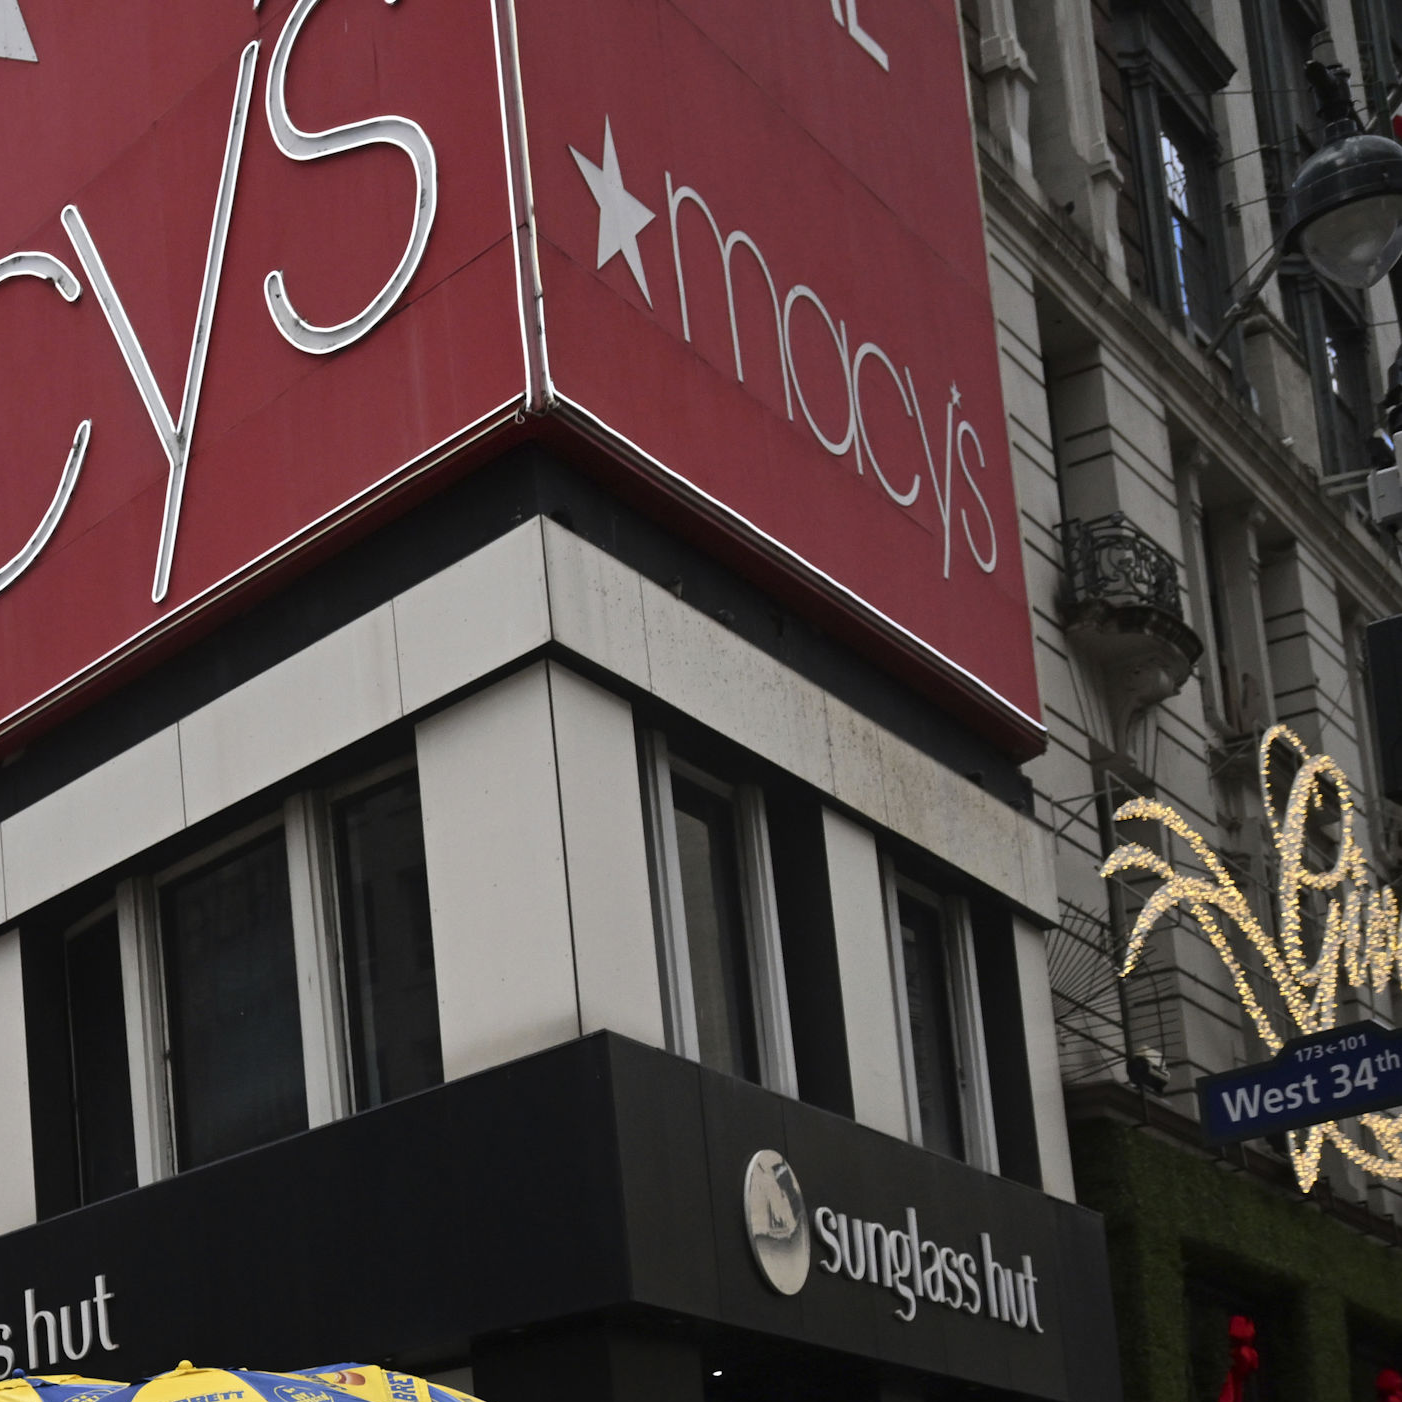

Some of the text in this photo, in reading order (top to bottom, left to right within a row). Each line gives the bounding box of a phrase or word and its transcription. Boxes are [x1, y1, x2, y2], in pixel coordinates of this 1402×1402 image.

[1221, 1049, 1402, 1123] West 34th
[813, 1206, 1045, 1334] sunglass hut
[23, 1274, 120, 1370] hut
